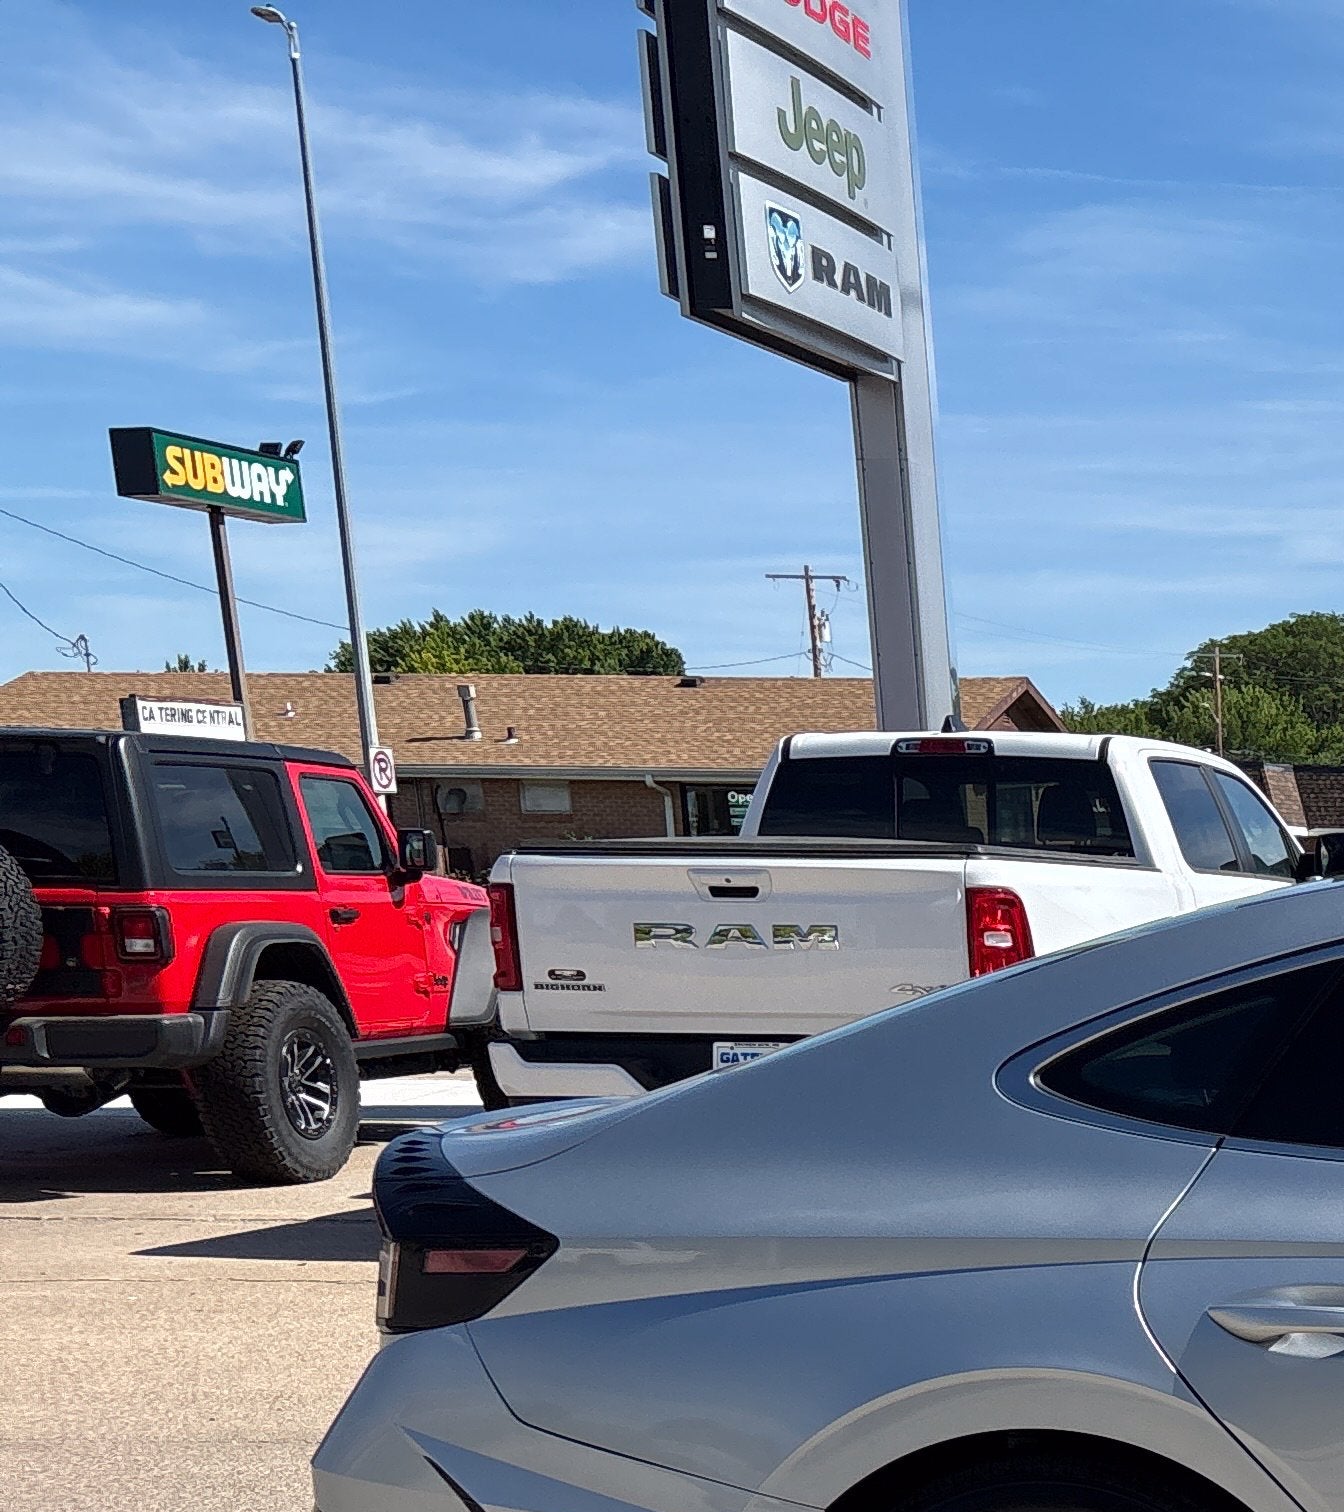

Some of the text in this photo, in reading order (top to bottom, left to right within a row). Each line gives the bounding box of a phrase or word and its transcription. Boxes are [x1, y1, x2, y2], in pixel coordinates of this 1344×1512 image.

[777, 76, 867, 200] Jeep
[810, 244, 893, 318] RAM
[163, 445, 295, 507] SUBWAY
[633, 922, 839, 950] RAM
